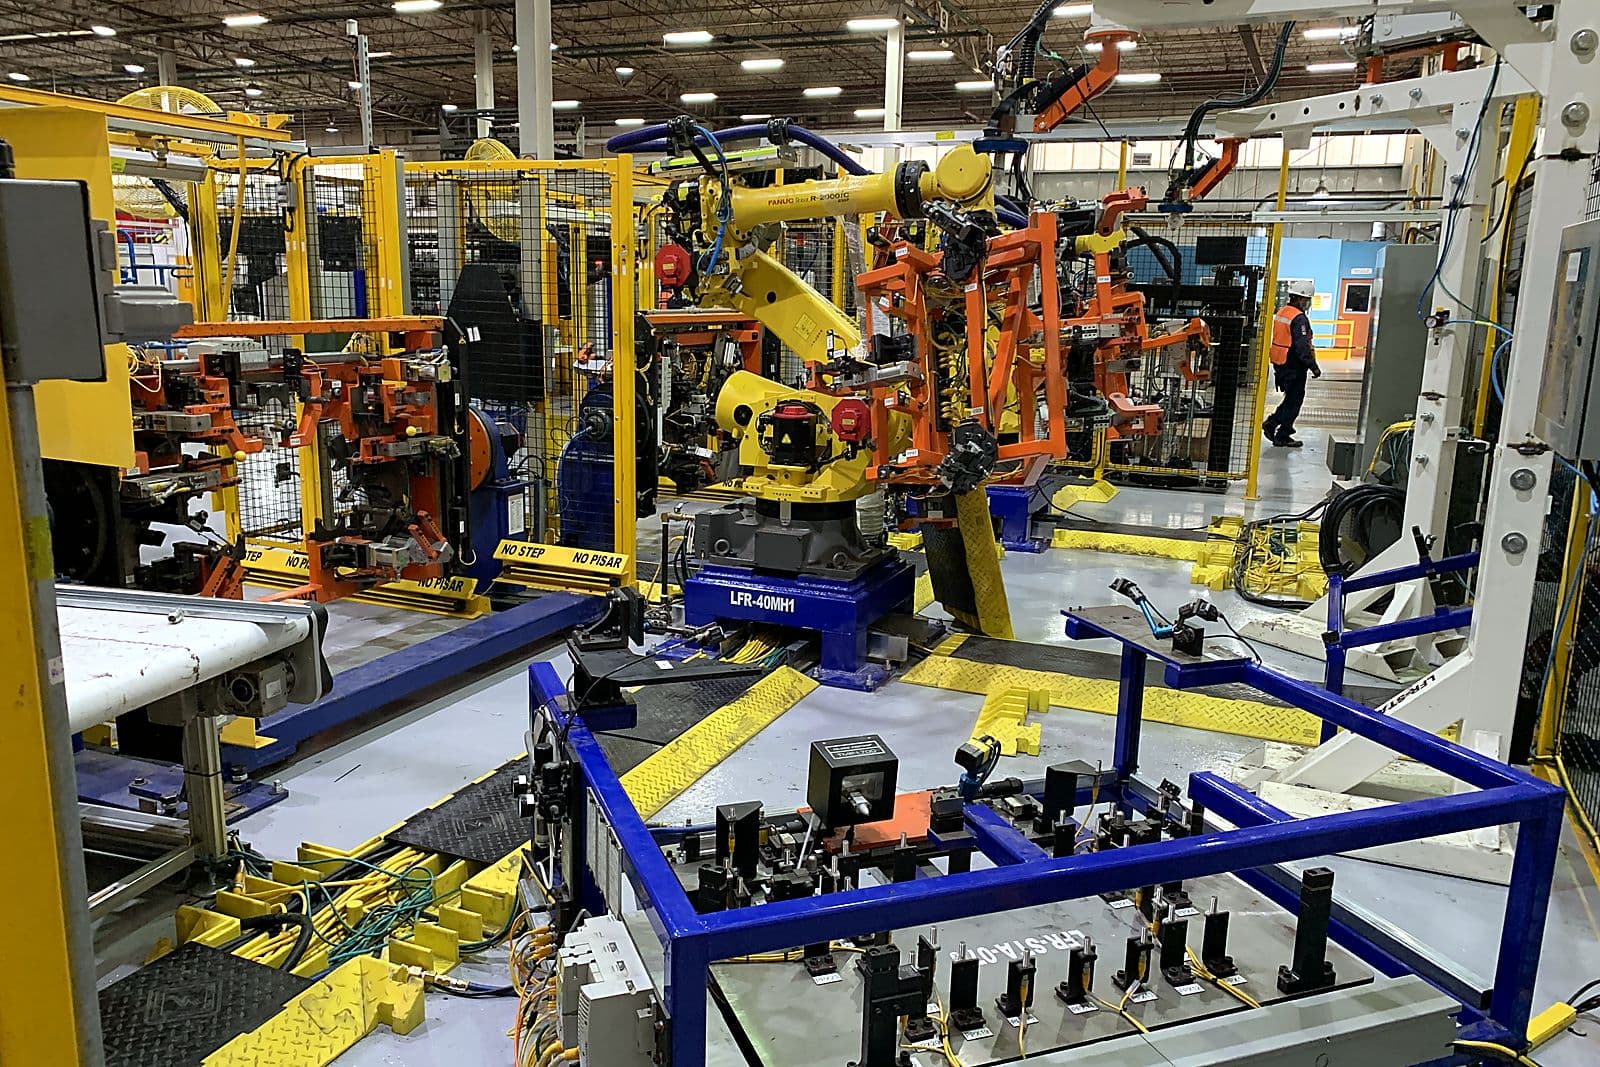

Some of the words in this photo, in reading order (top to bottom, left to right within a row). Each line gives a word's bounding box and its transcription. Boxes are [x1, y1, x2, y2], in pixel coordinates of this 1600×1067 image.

[768, 198, 794, 206] FANUC
[246, 550, 263, 562] TEP
[285, 555, 300, 568] NO
[501, 544, 518, 555] NO
[518, 546, 545, 558] STEP
[572, 552, 589, 564] NO
[589, 554, 623, 569] PISAR
[434, 576, 464, 592] PISAR
[730, 590, 795, 613] LFR-40MH1
[1378, 674, 1436, 714] LFR-STA
